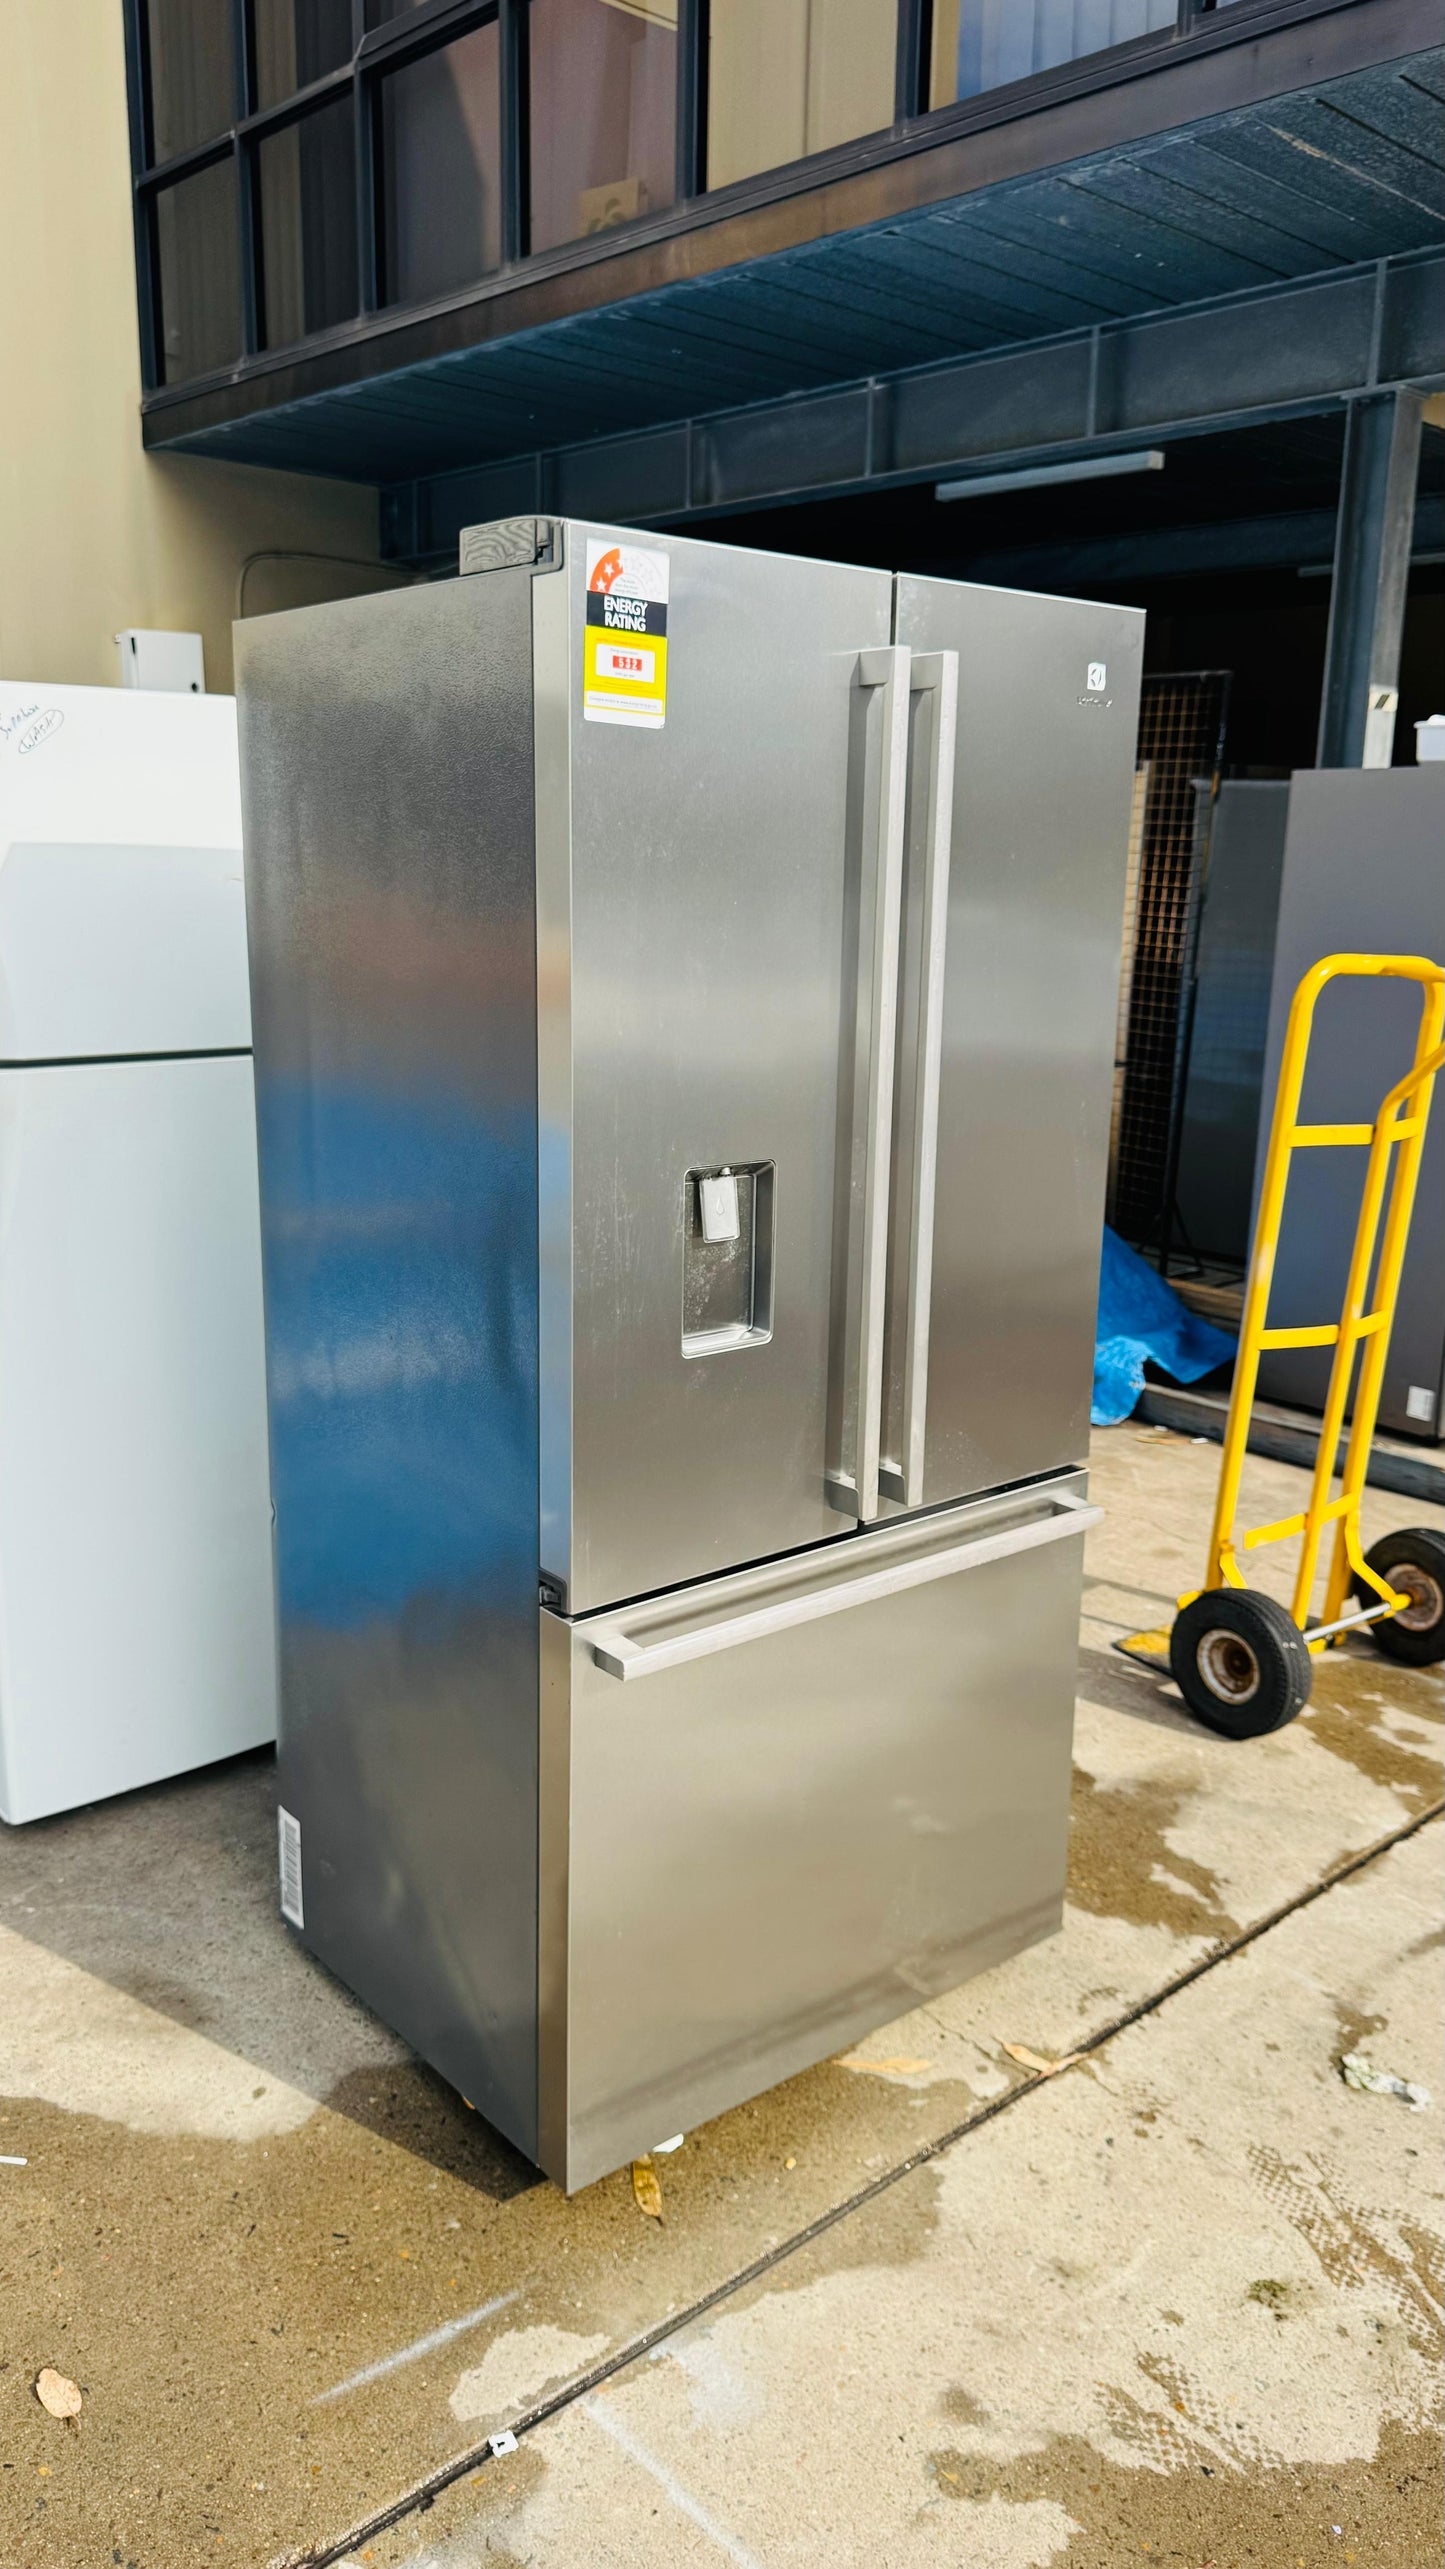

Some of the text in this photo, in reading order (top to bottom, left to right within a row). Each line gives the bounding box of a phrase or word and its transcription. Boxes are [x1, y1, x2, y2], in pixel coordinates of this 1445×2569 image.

[604, 595, 648, 617] ENERGY
[605, 611, 646, 632] RATING
[618, 657, 638, 671] 532
